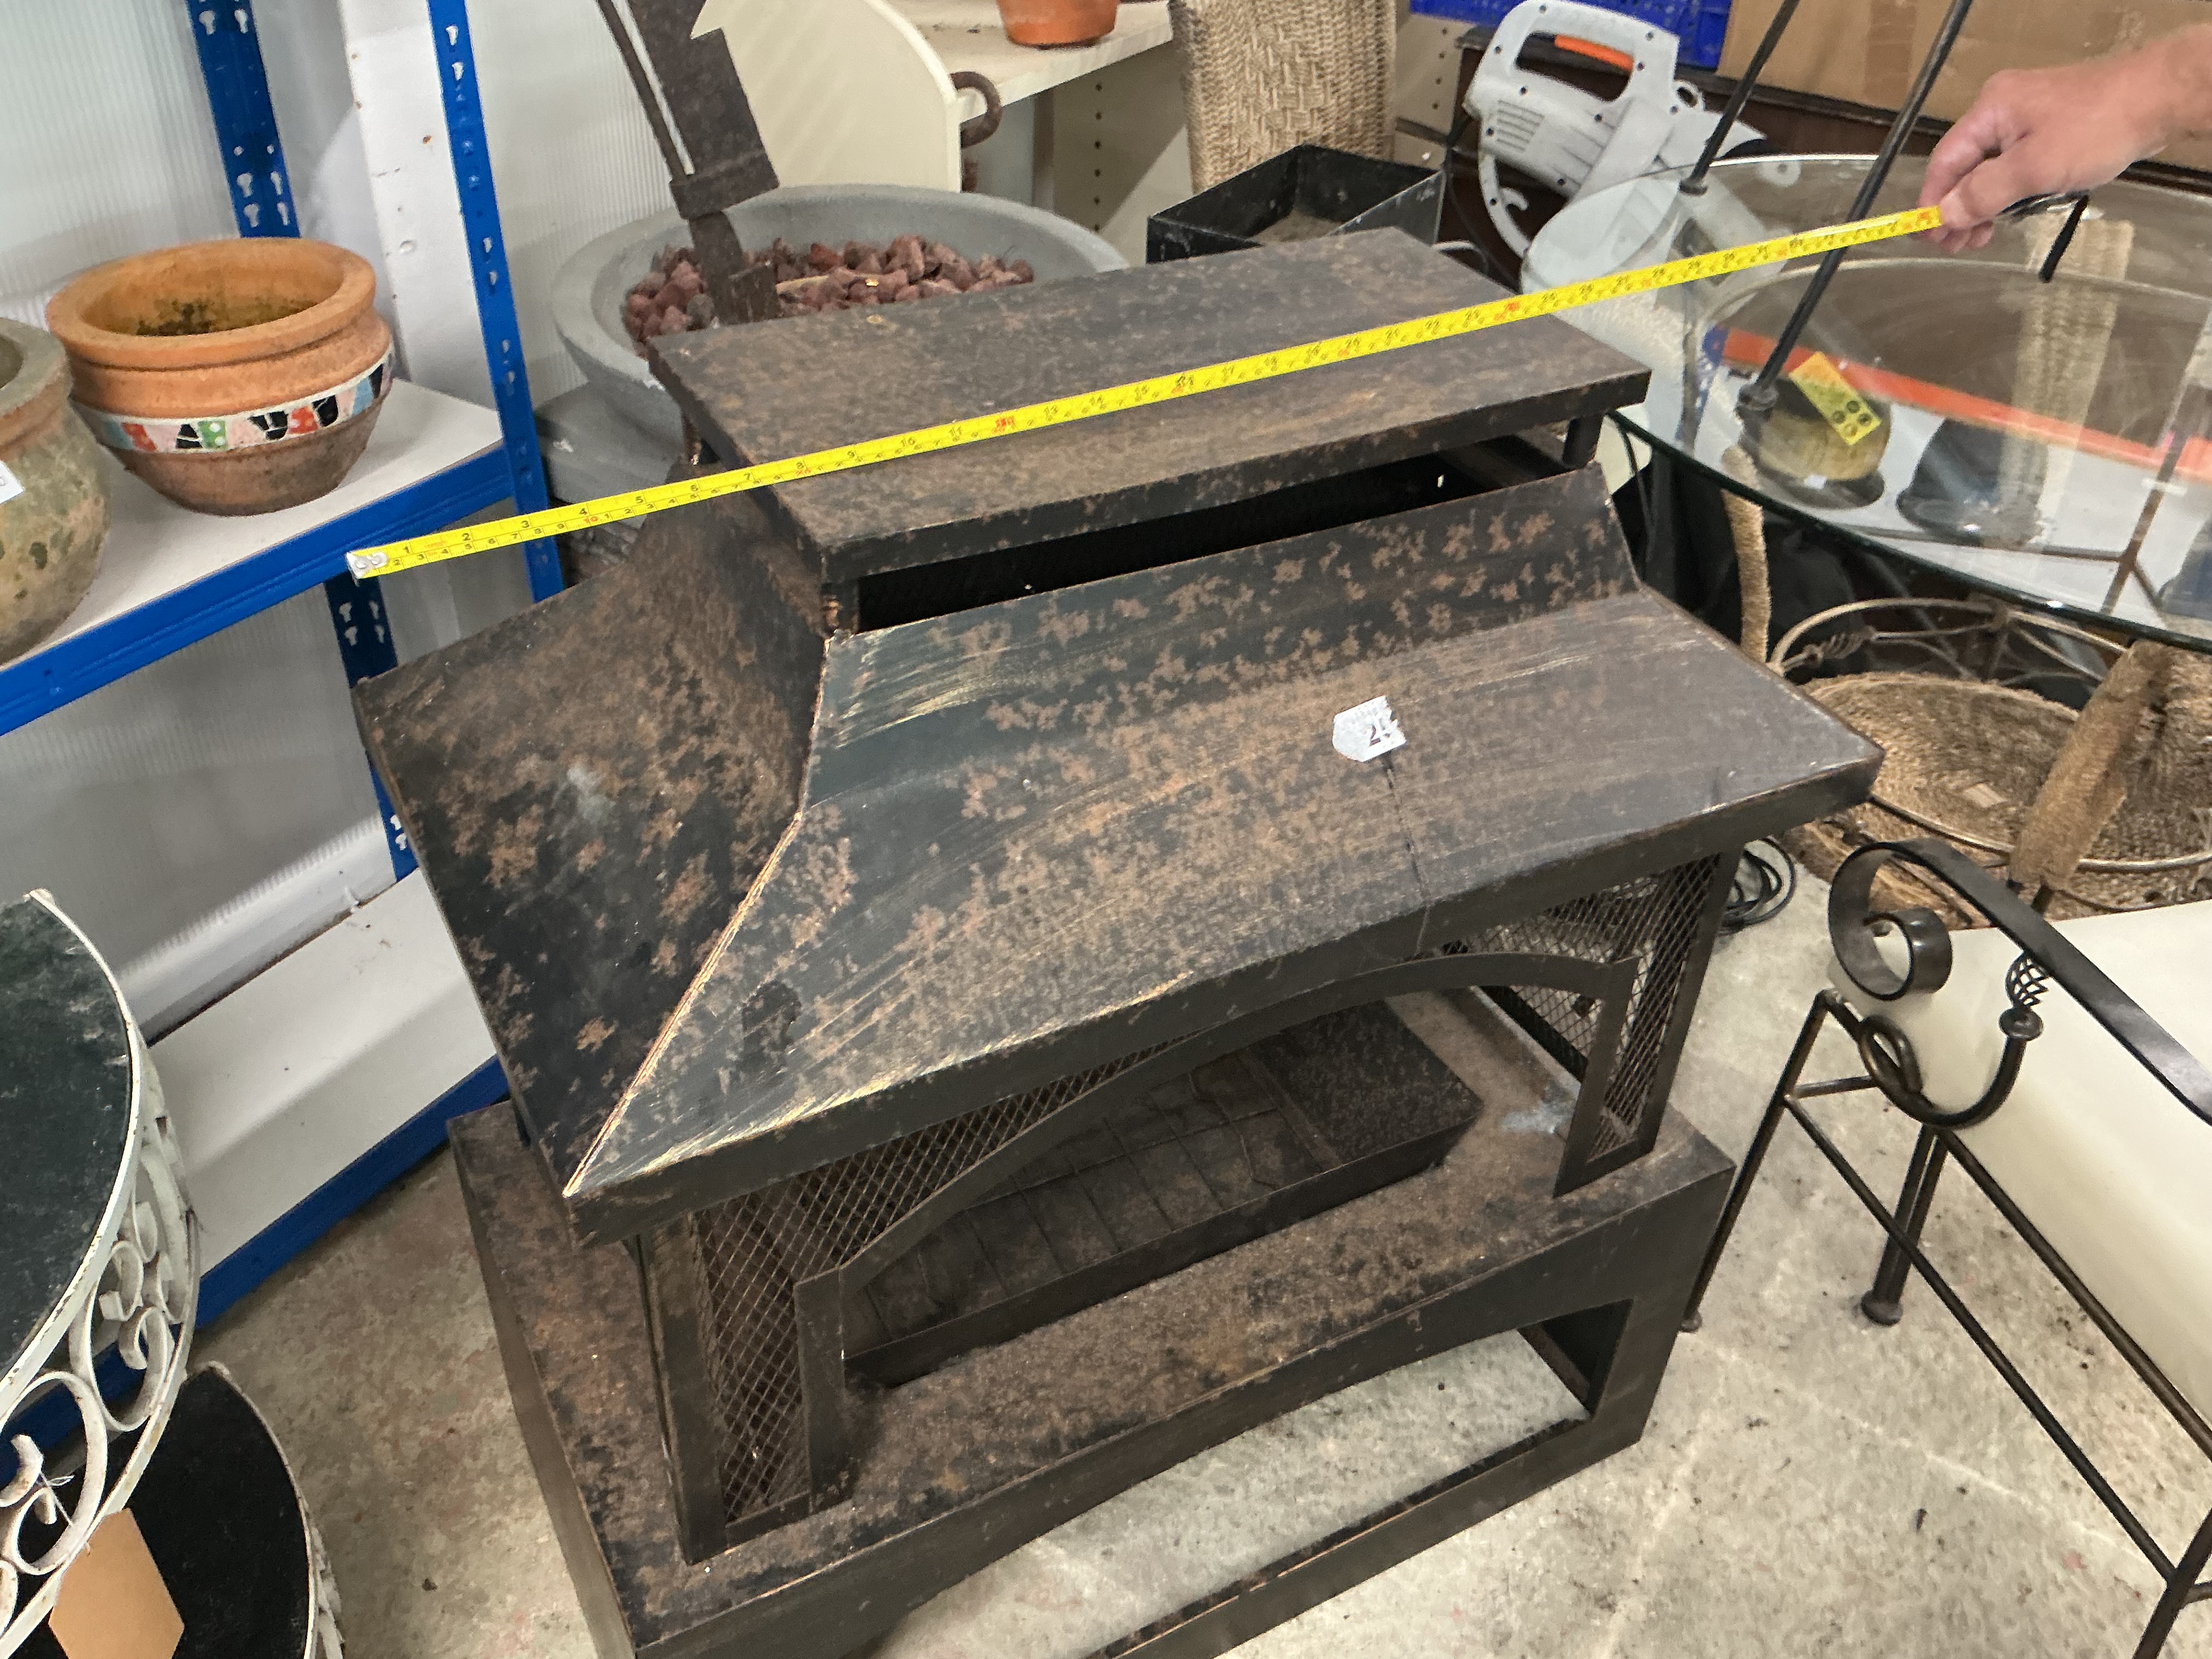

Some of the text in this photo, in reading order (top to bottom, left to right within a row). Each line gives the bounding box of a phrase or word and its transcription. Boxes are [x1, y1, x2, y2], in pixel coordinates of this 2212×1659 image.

[403, 545, 410, 554] 1
[461, 533, 471, 541] 2
[521, 520, 529, 528] 3
[635, 495, 644, 504] 5
[743, 472, 751, 481] 7
[796, 461, 804, 470] 8
[847, 450, 855, 459] 9
[900, 436, 917, 447] 10
